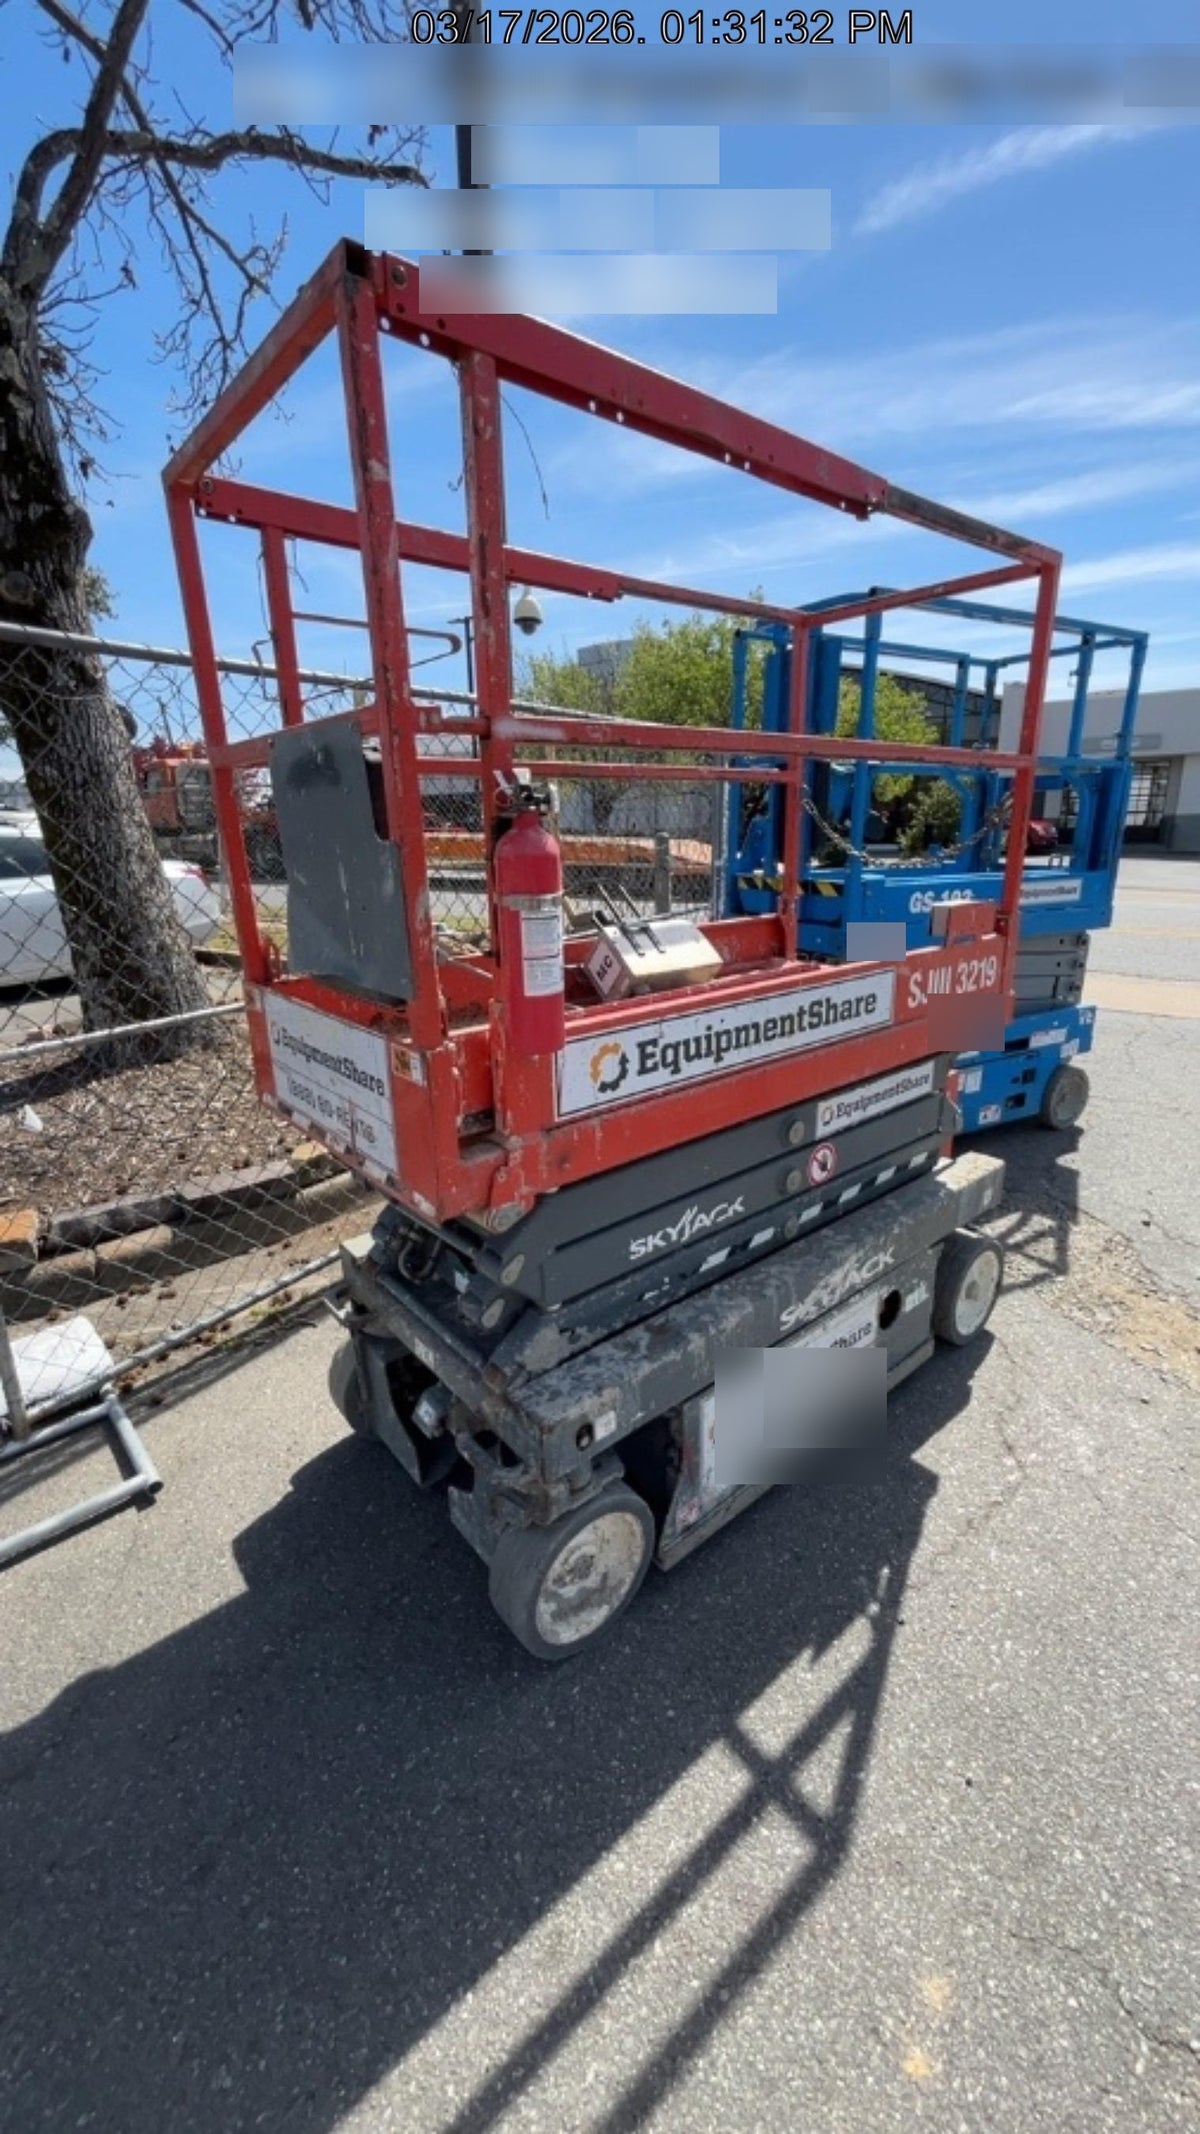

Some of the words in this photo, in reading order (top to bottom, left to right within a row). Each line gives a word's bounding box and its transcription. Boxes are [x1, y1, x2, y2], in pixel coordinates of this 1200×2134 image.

[909, 890, 935, 914] GS
[956, 955, 997, 994] 3219
[636, 992, 877, 1077] EquipmentShare
[281, 1027, 385, 1097] EquipmentShare
[836, 1073, 930, 1118] EquipmentShare
[629, 1196, 745, 1260] SKYJACK
